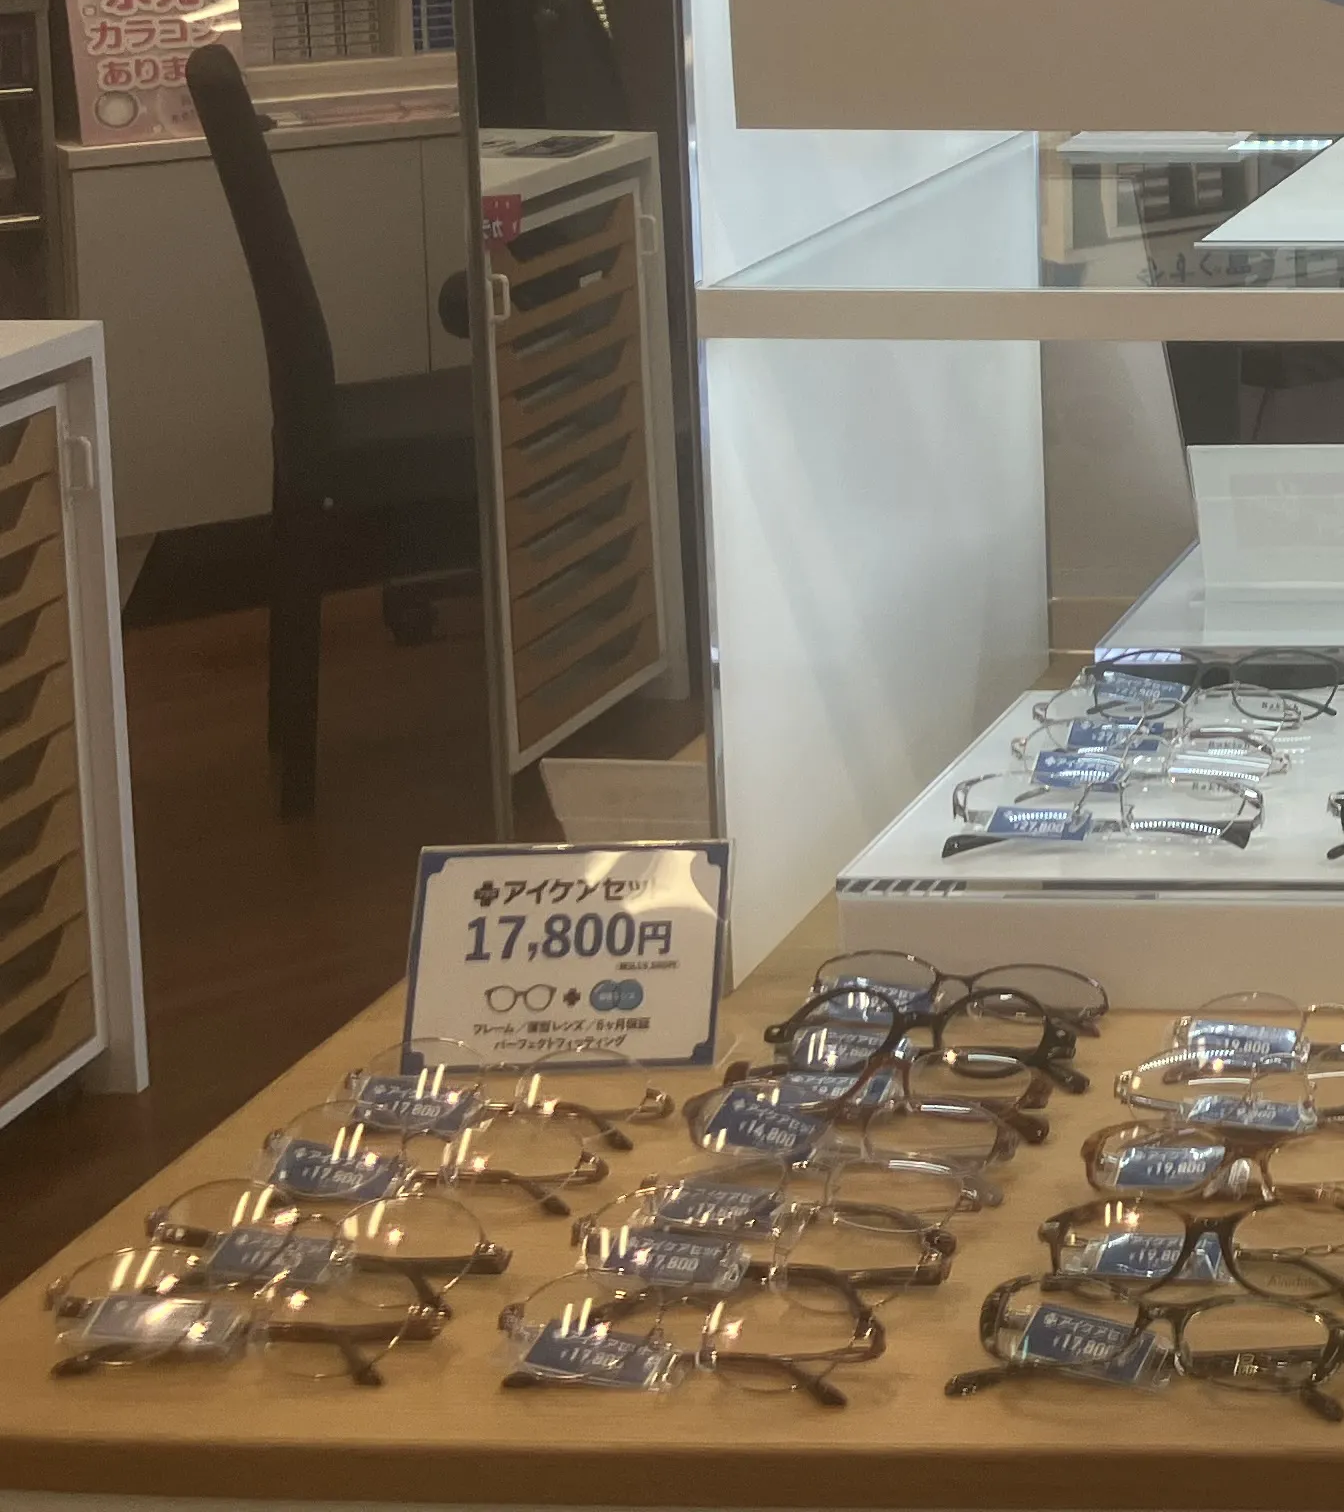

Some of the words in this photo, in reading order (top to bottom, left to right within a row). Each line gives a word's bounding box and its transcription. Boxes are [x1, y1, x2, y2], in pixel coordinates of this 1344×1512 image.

[102, 57, 190, 88] ありま
[464, 911, 673, 963] 17,800円
[1128, 1246, 1182, 1267] ¥19,80
[1057, 1314, 1127, 1345] アイケアセ
